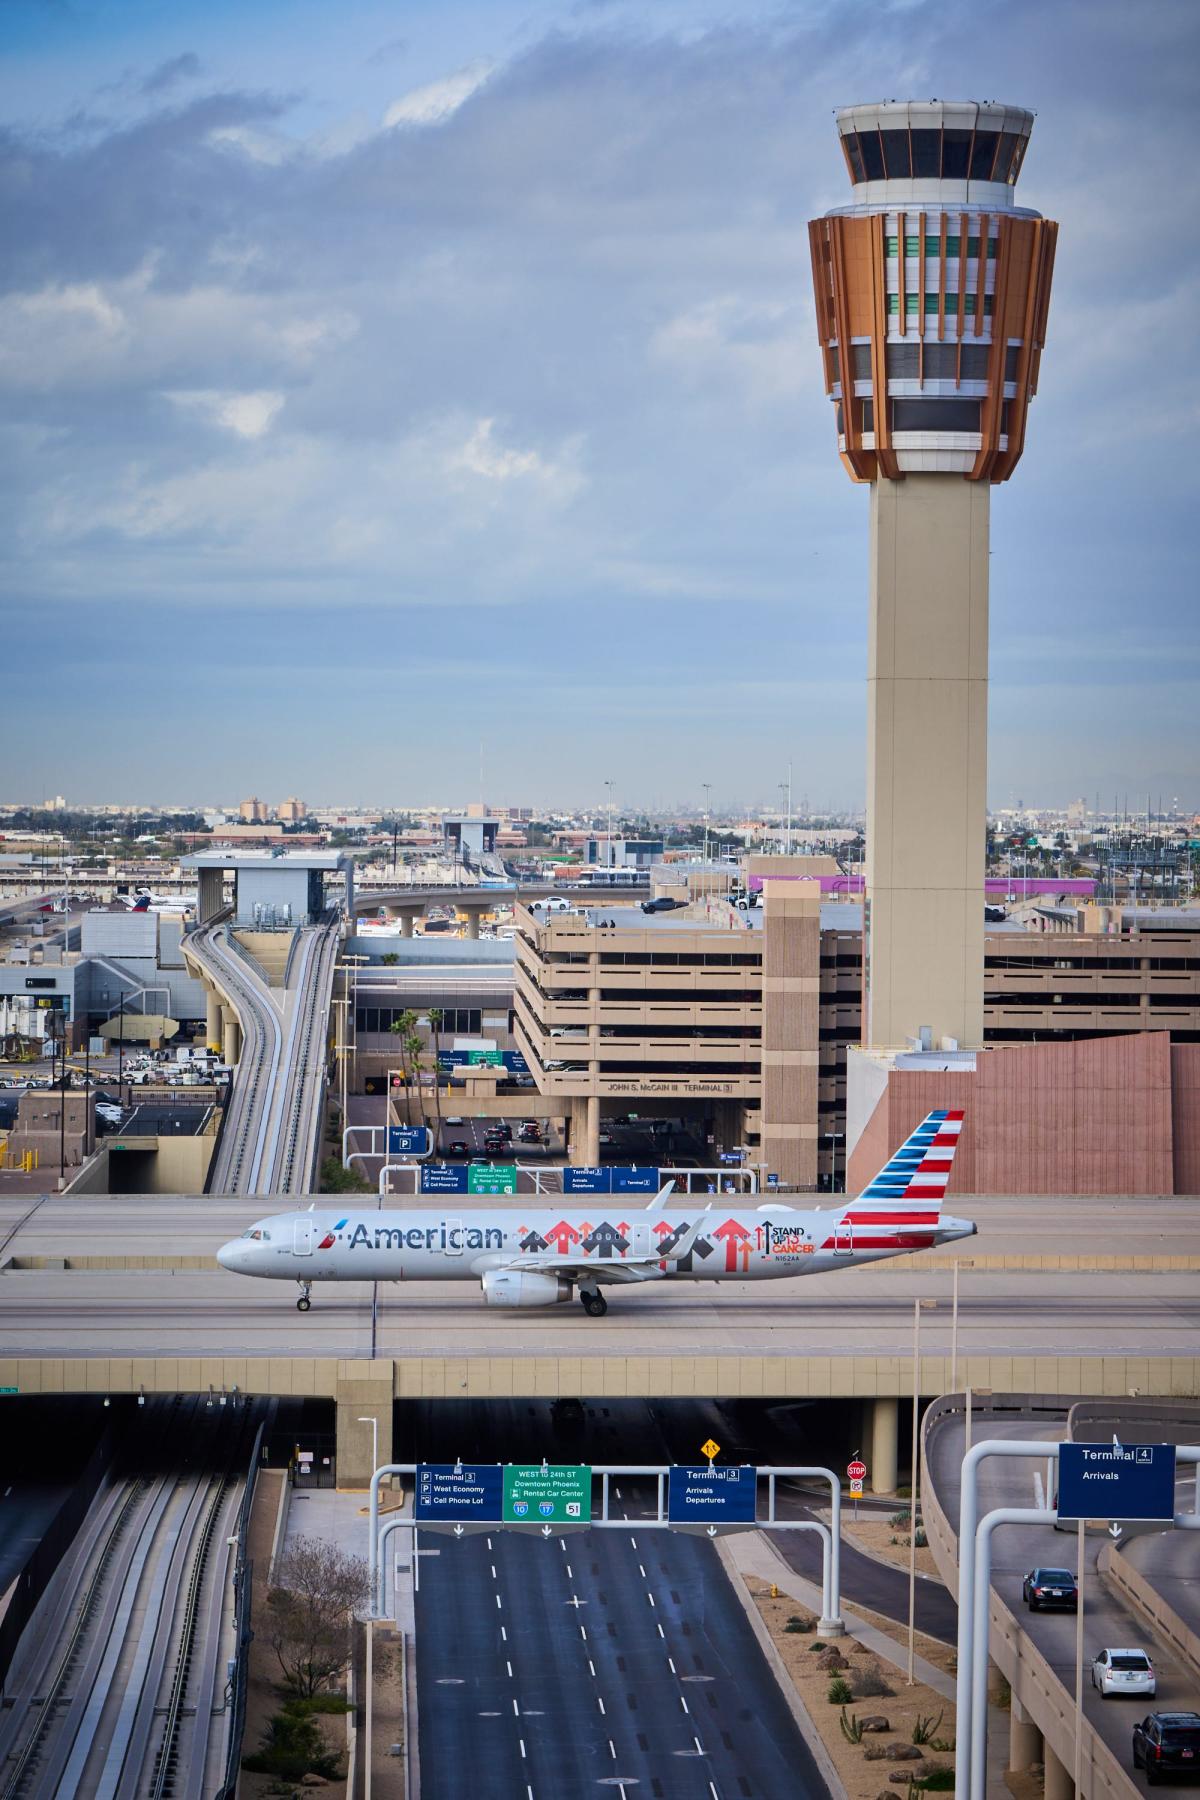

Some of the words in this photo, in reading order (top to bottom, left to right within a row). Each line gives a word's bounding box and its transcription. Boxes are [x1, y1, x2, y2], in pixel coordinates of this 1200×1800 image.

[350, 1222, 502, 1249] American
[772, 1227, 804, 1236] STAND
[772, 1236, 786, 1244] UP
[772, 1244, 815, 1253] CANCER
[1141, 1450, 1148, 1458] 4
[1083, 1472, 1119, 1480] Arrivals
[568, 1505, 579, 1513] 51
